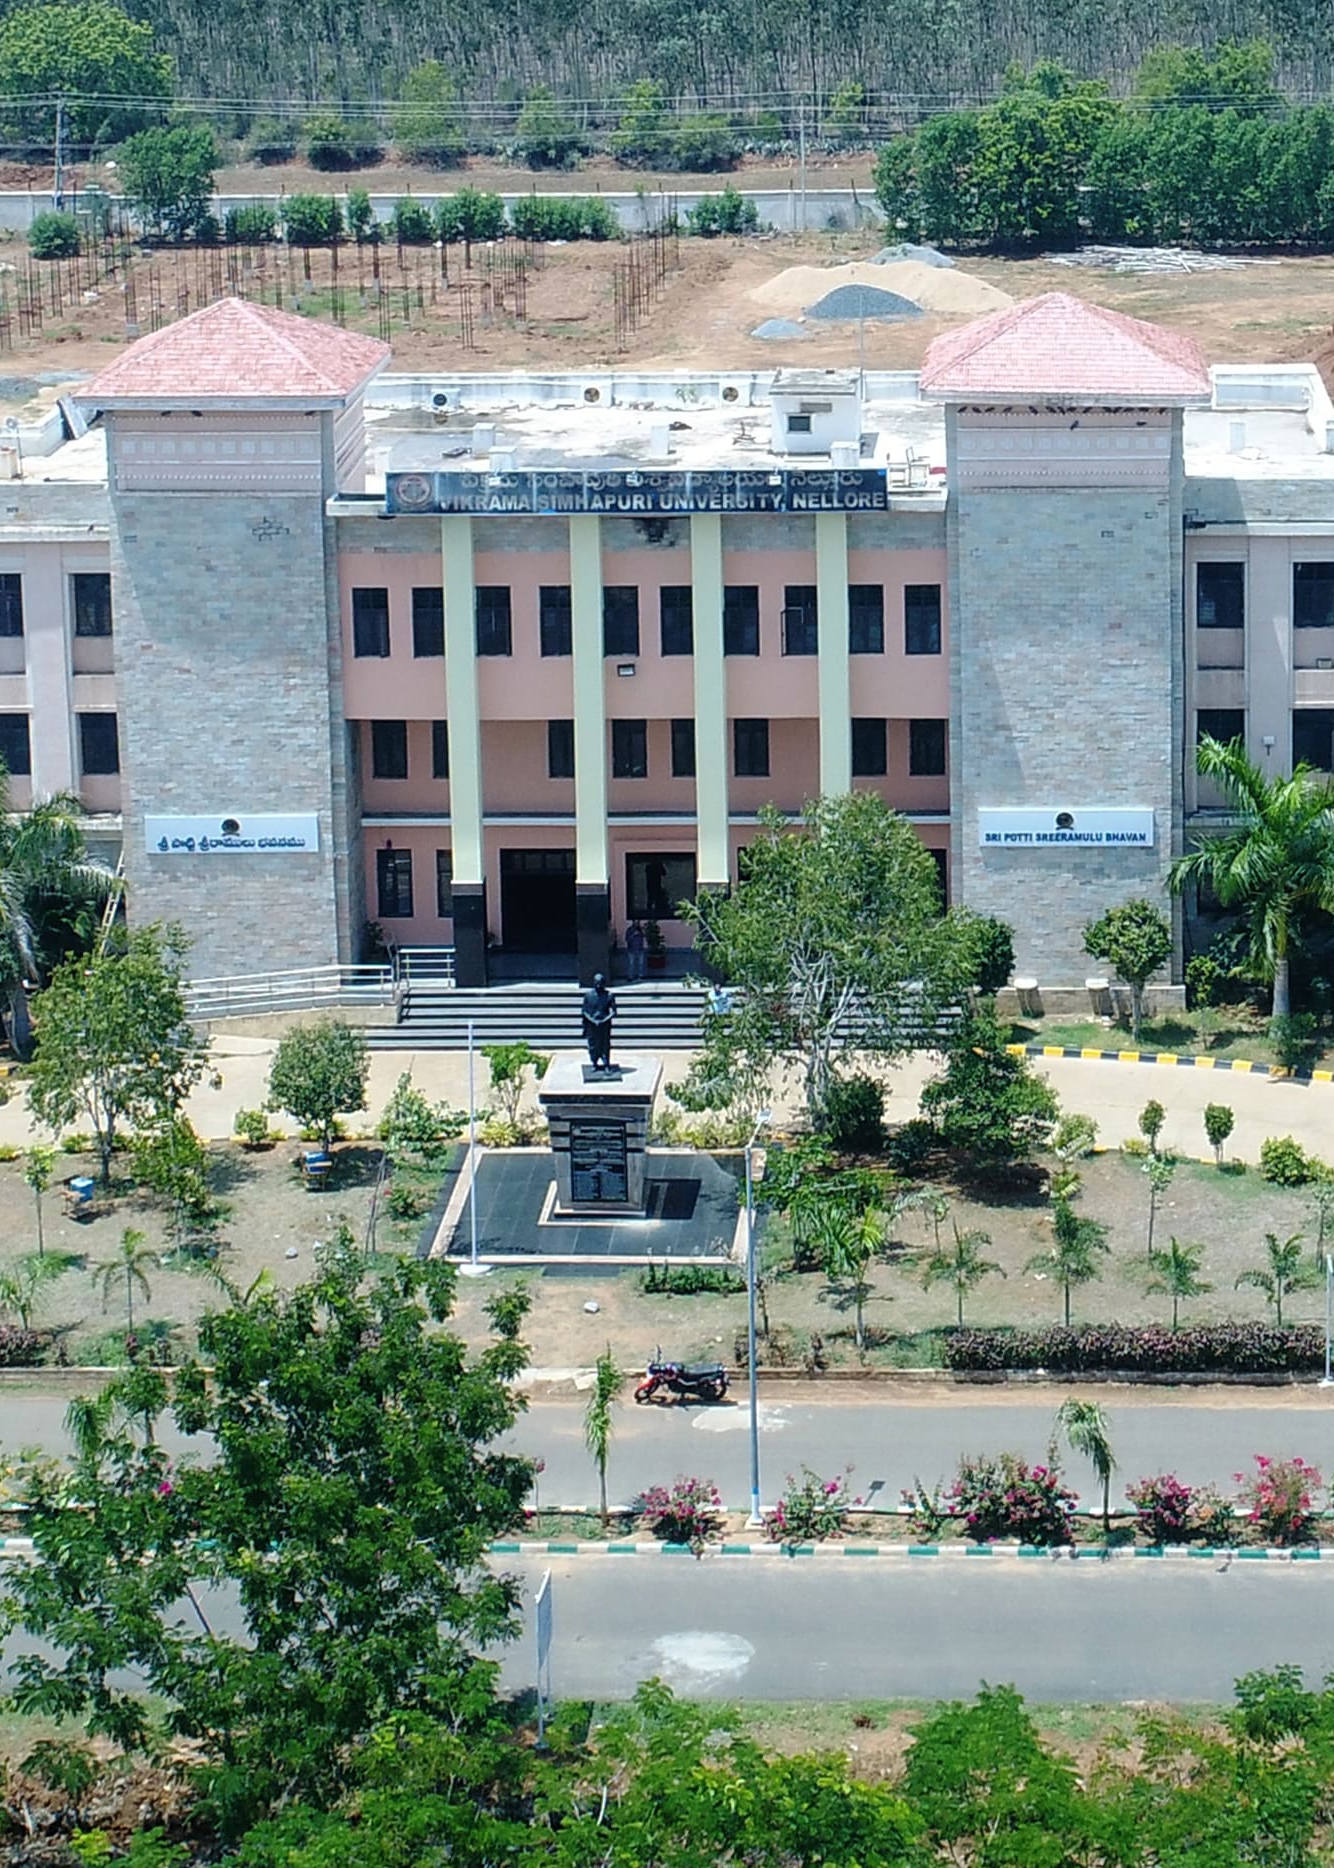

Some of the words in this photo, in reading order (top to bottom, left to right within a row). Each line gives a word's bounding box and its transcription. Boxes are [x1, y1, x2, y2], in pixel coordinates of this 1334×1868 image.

[440, 494, 531, 510] VIKRAMA
[537, 494, 652, 510] SIMHAPURI
[660, 492, 785, 511] UNIVERSITY,
[793, 492, 885, 508] NELLORE
[157, 836, 169, 851] శ్రీ
[985, 832, 1001, 842] SRI
[1004, 832, 1033, 842] POTTI
[1035, 832, 1102, 842] SREERAMULU
[1105, 832, 1146, 842] BHAVAN
